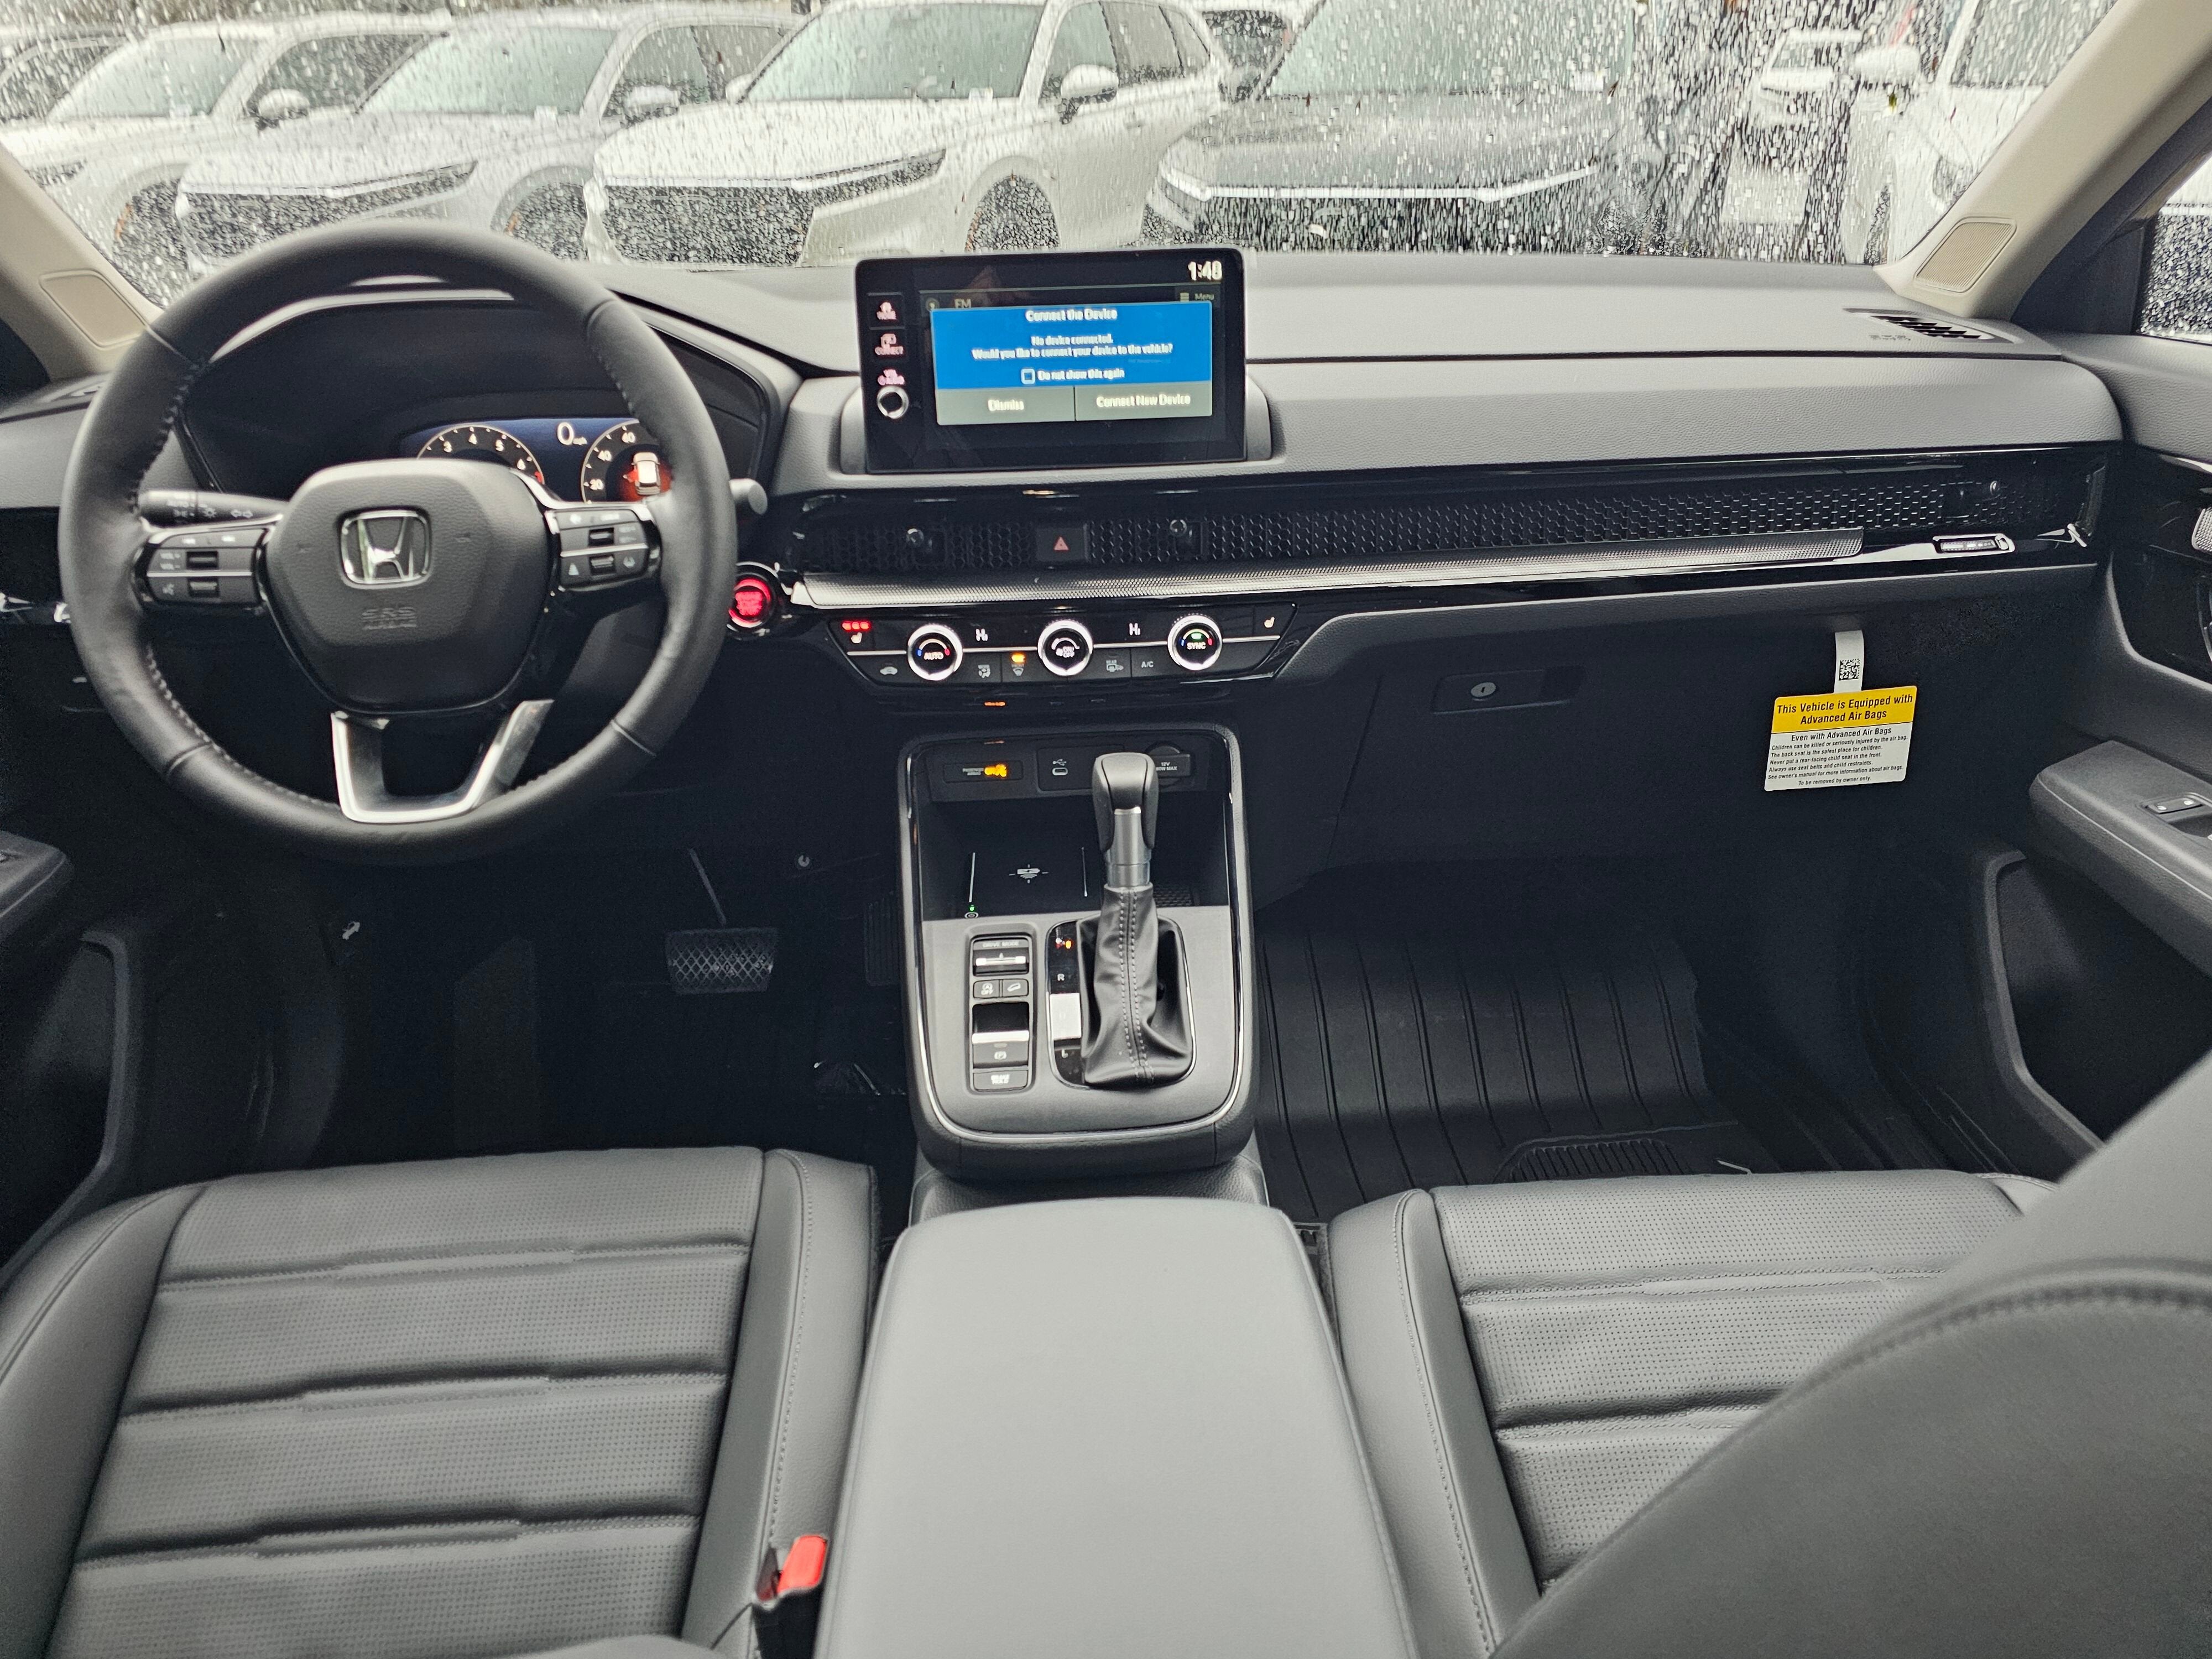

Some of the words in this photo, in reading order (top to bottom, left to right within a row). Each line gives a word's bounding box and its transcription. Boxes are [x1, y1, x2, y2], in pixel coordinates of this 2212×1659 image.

[954, 299, 971, 308] FM
[1026, 310, 1066, 322] Connect
[1066, 309, 1083, 321] the
[1084, 309, 1117, 320] Device
[1045, 335, 1070, 345] device
[972, 349, 999, 359] Would
[1000, 350, 1015, 360] you
[1015, 348, 1030, 358] like
[1030, 348, 1040, 358] to
[1041, 348, 1072, 357] connect
[1072, 348, 1091, 357] your
[1092, 346, 1117, 356] device
[1118, 346, 1127, 354] to
[1128, 345, 1141, 354] the
[1142, 343, 1173, 354] vehicle?
[1037, 371, 1050, 380] Do
[1051, 371, 1065, 380] not
[1066, 370, 1087, 379] show
[1087, 369, 1103, 379] this
[1103, 368, 1125, 380] again
[1097, 395, 1135, 408] Connect
[1136, 395, 1157, 406] New
[1159, 394, 1191, 405] Device
[469, 433, 477, 445] 4
[557, 422, 574, 445] 0
[622, 432, 635, 443] 60
[444, 441, 452, 453] 3
[495, 440, 504, 452] 5
[598, 450, 612, 461] 40
[589, 479, 603, 490] 20
[1777, 705, 1796, 714] This
[1801, 702, 1834, 712] Vehicle
[1838, 700, 1845, 709] is
[1849, 696, 1890, 711] Equipped
[1894, 694, 1912, 704] with
[1801, 713, 1845, 724] Advanced
[1865, 710, 1887, 721] Bags
[1827, 729, 1860, 738] Advanced
